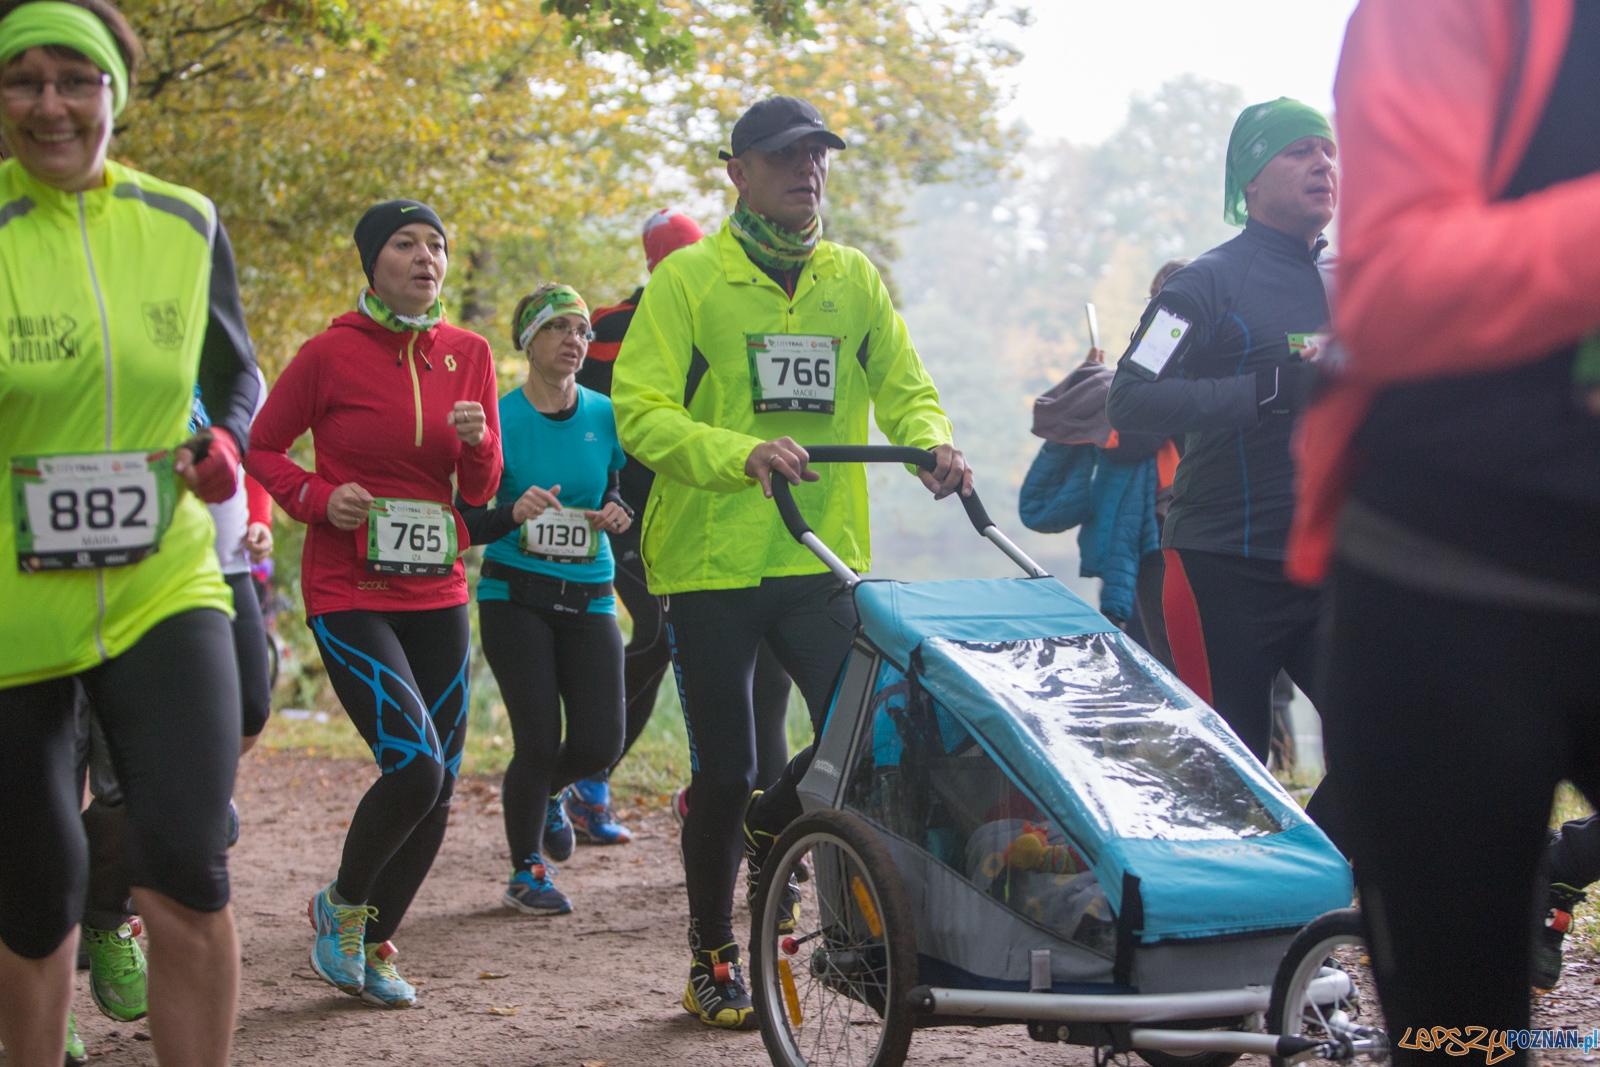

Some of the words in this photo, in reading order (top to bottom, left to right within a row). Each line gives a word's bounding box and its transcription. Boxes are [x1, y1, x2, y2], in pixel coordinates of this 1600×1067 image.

[771, 357, 831, 388] 766
[793, 389, 817, 397] MACIEJ
[50, 486, 148, 531] 882
[81, 535, 119, 546] MARIA
[390, 522, 441, 553] 765
[536, 523, 586, 547] 1130
